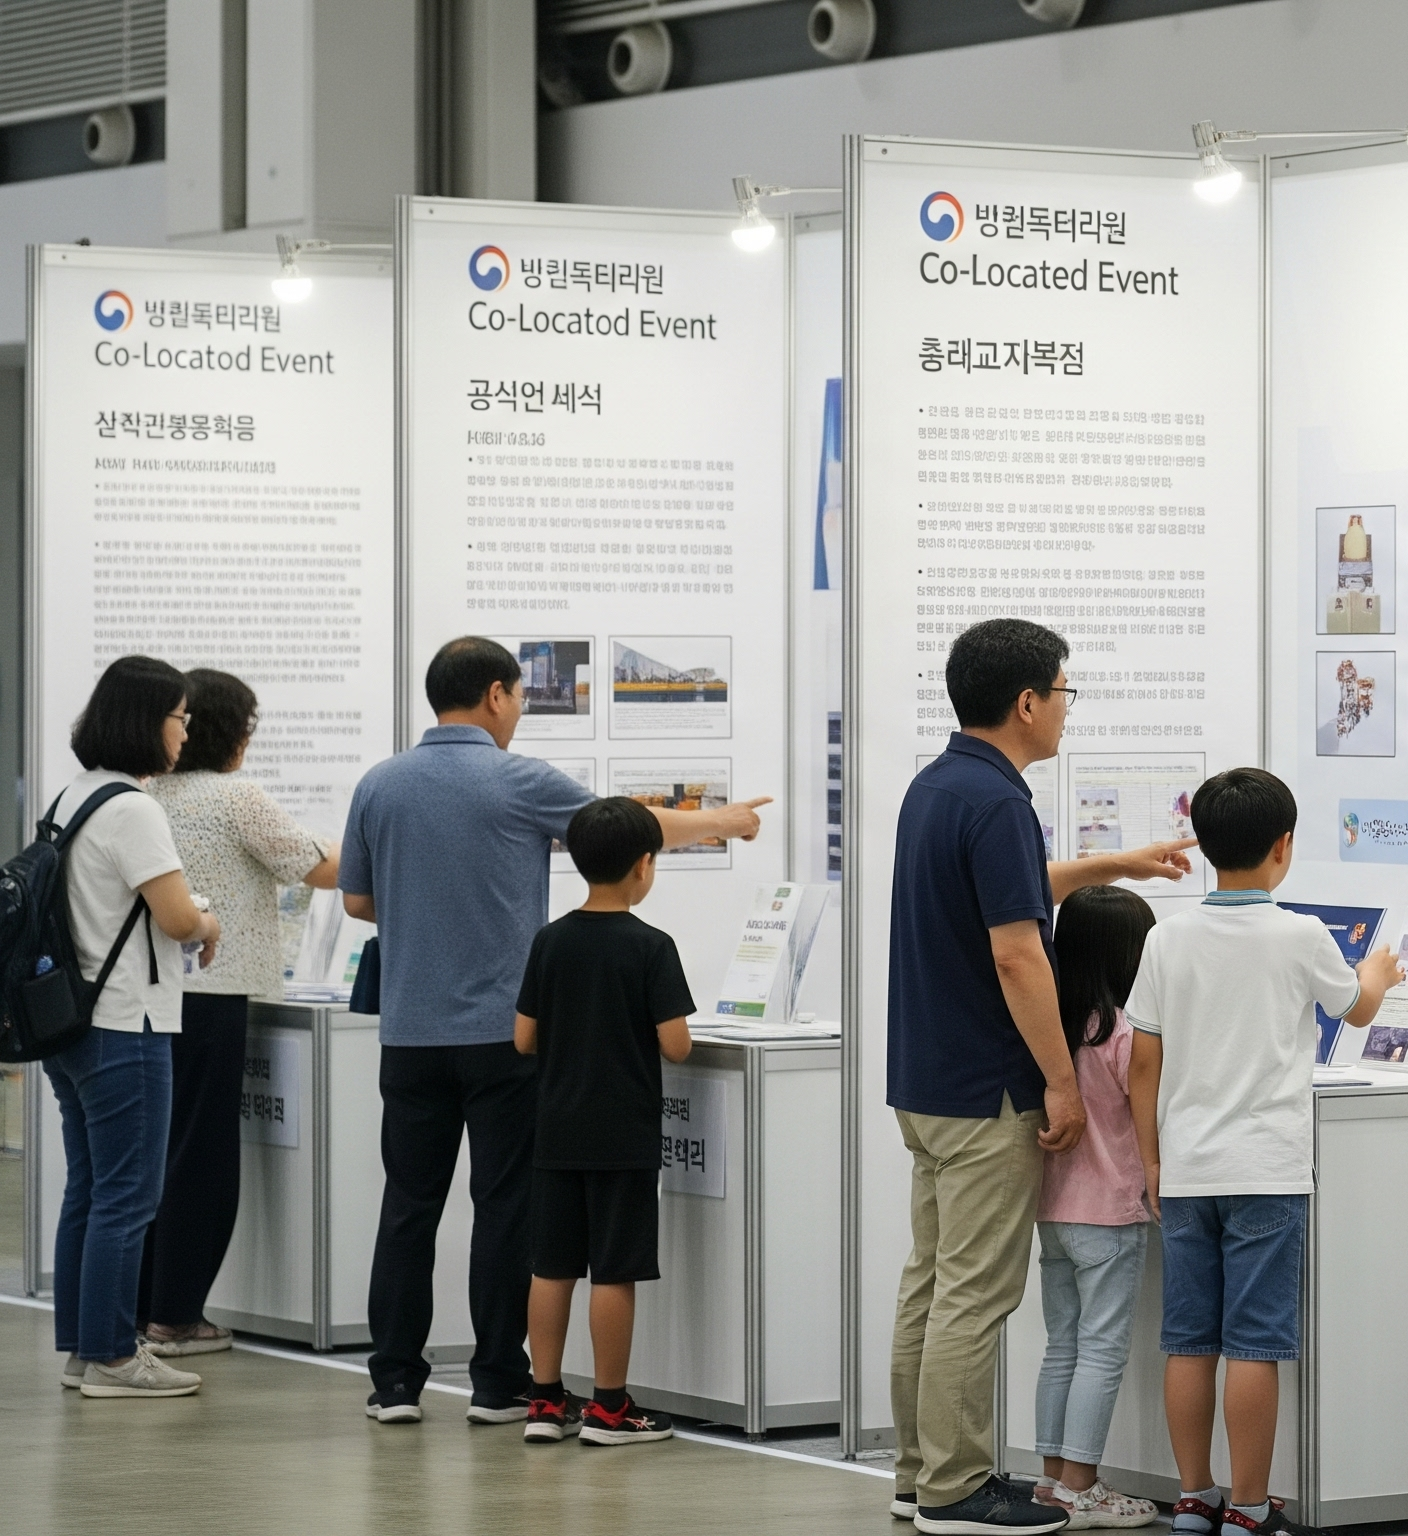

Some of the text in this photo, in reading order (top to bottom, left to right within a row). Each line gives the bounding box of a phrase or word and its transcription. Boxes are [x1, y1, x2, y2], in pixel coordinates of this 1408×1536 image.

[919, 251, 1179, 296] Co-Located Event
[639, 310, 717, 340] Event
[261, 345, 335, 375] Event
